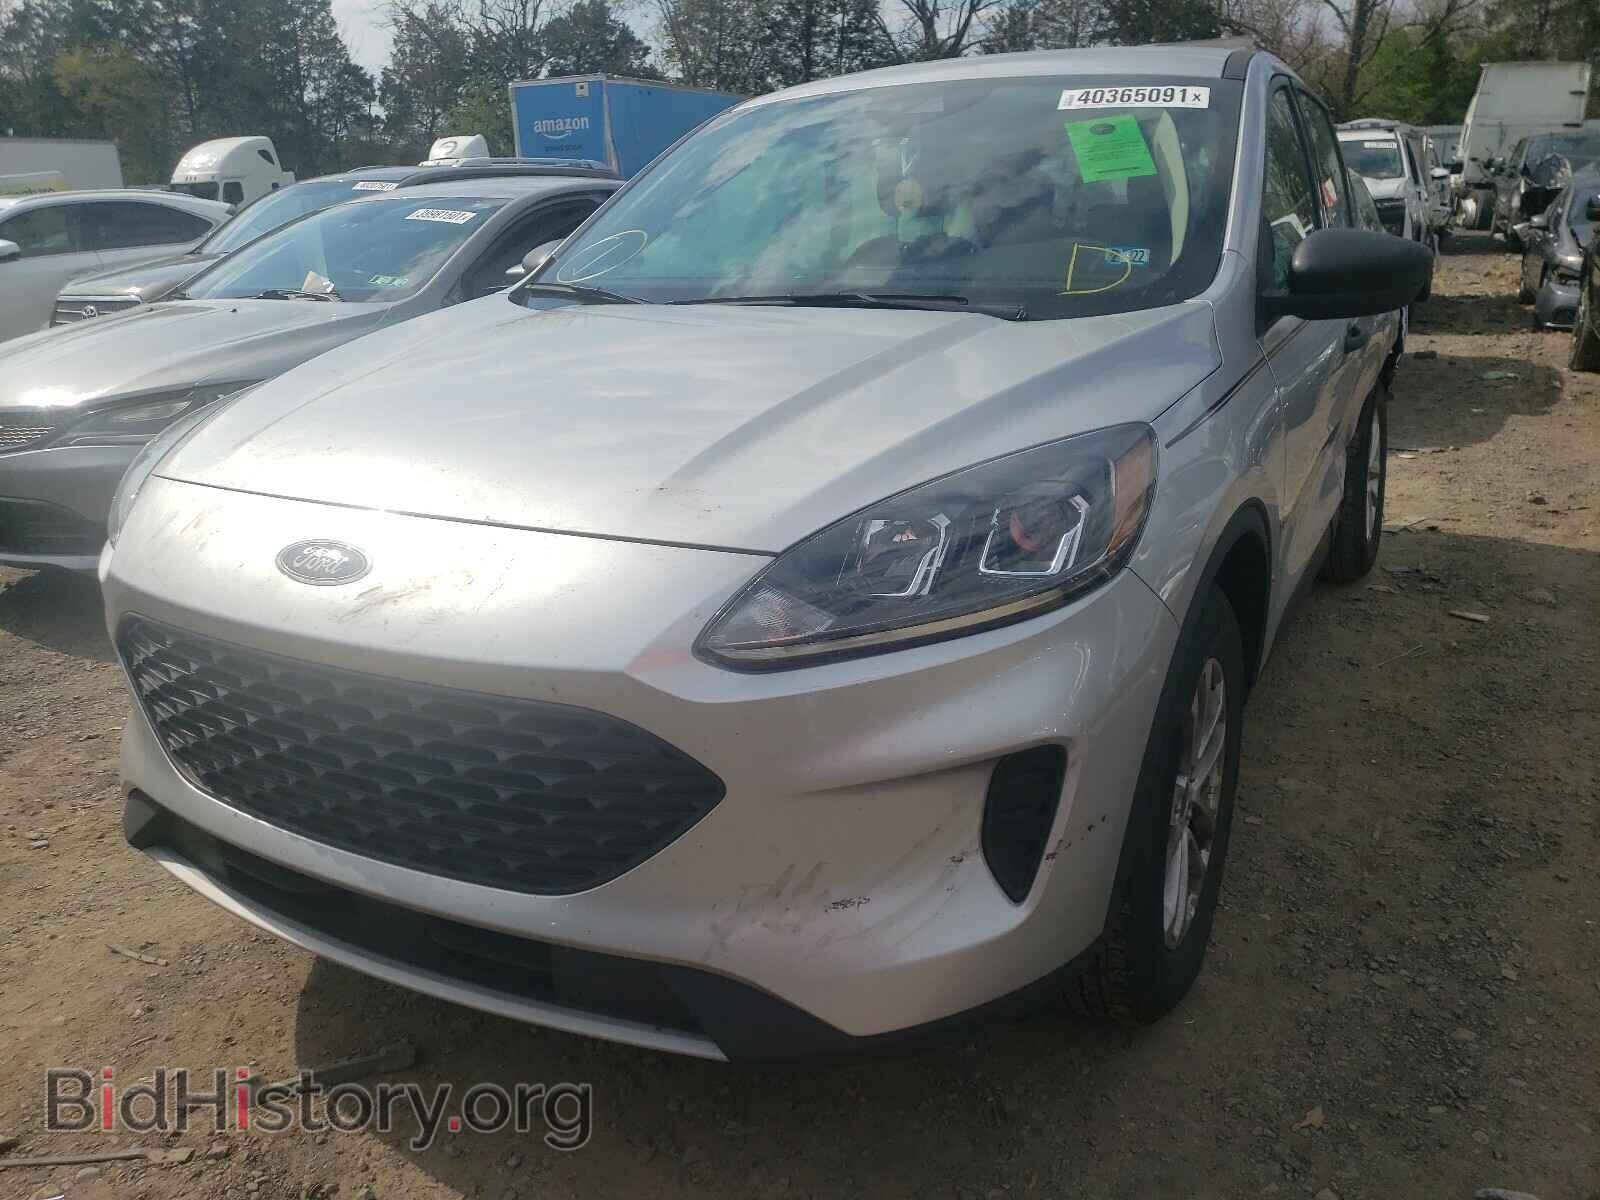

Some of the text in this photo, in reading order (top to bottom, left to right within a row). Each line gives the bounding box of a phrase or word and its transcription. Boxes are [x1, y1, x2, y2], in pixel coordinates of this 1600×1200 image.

[1078, 87, 1188, 104] 40365091
[534, 116, 589, 133] amazon
[293, 546, 349, 575] Ford
